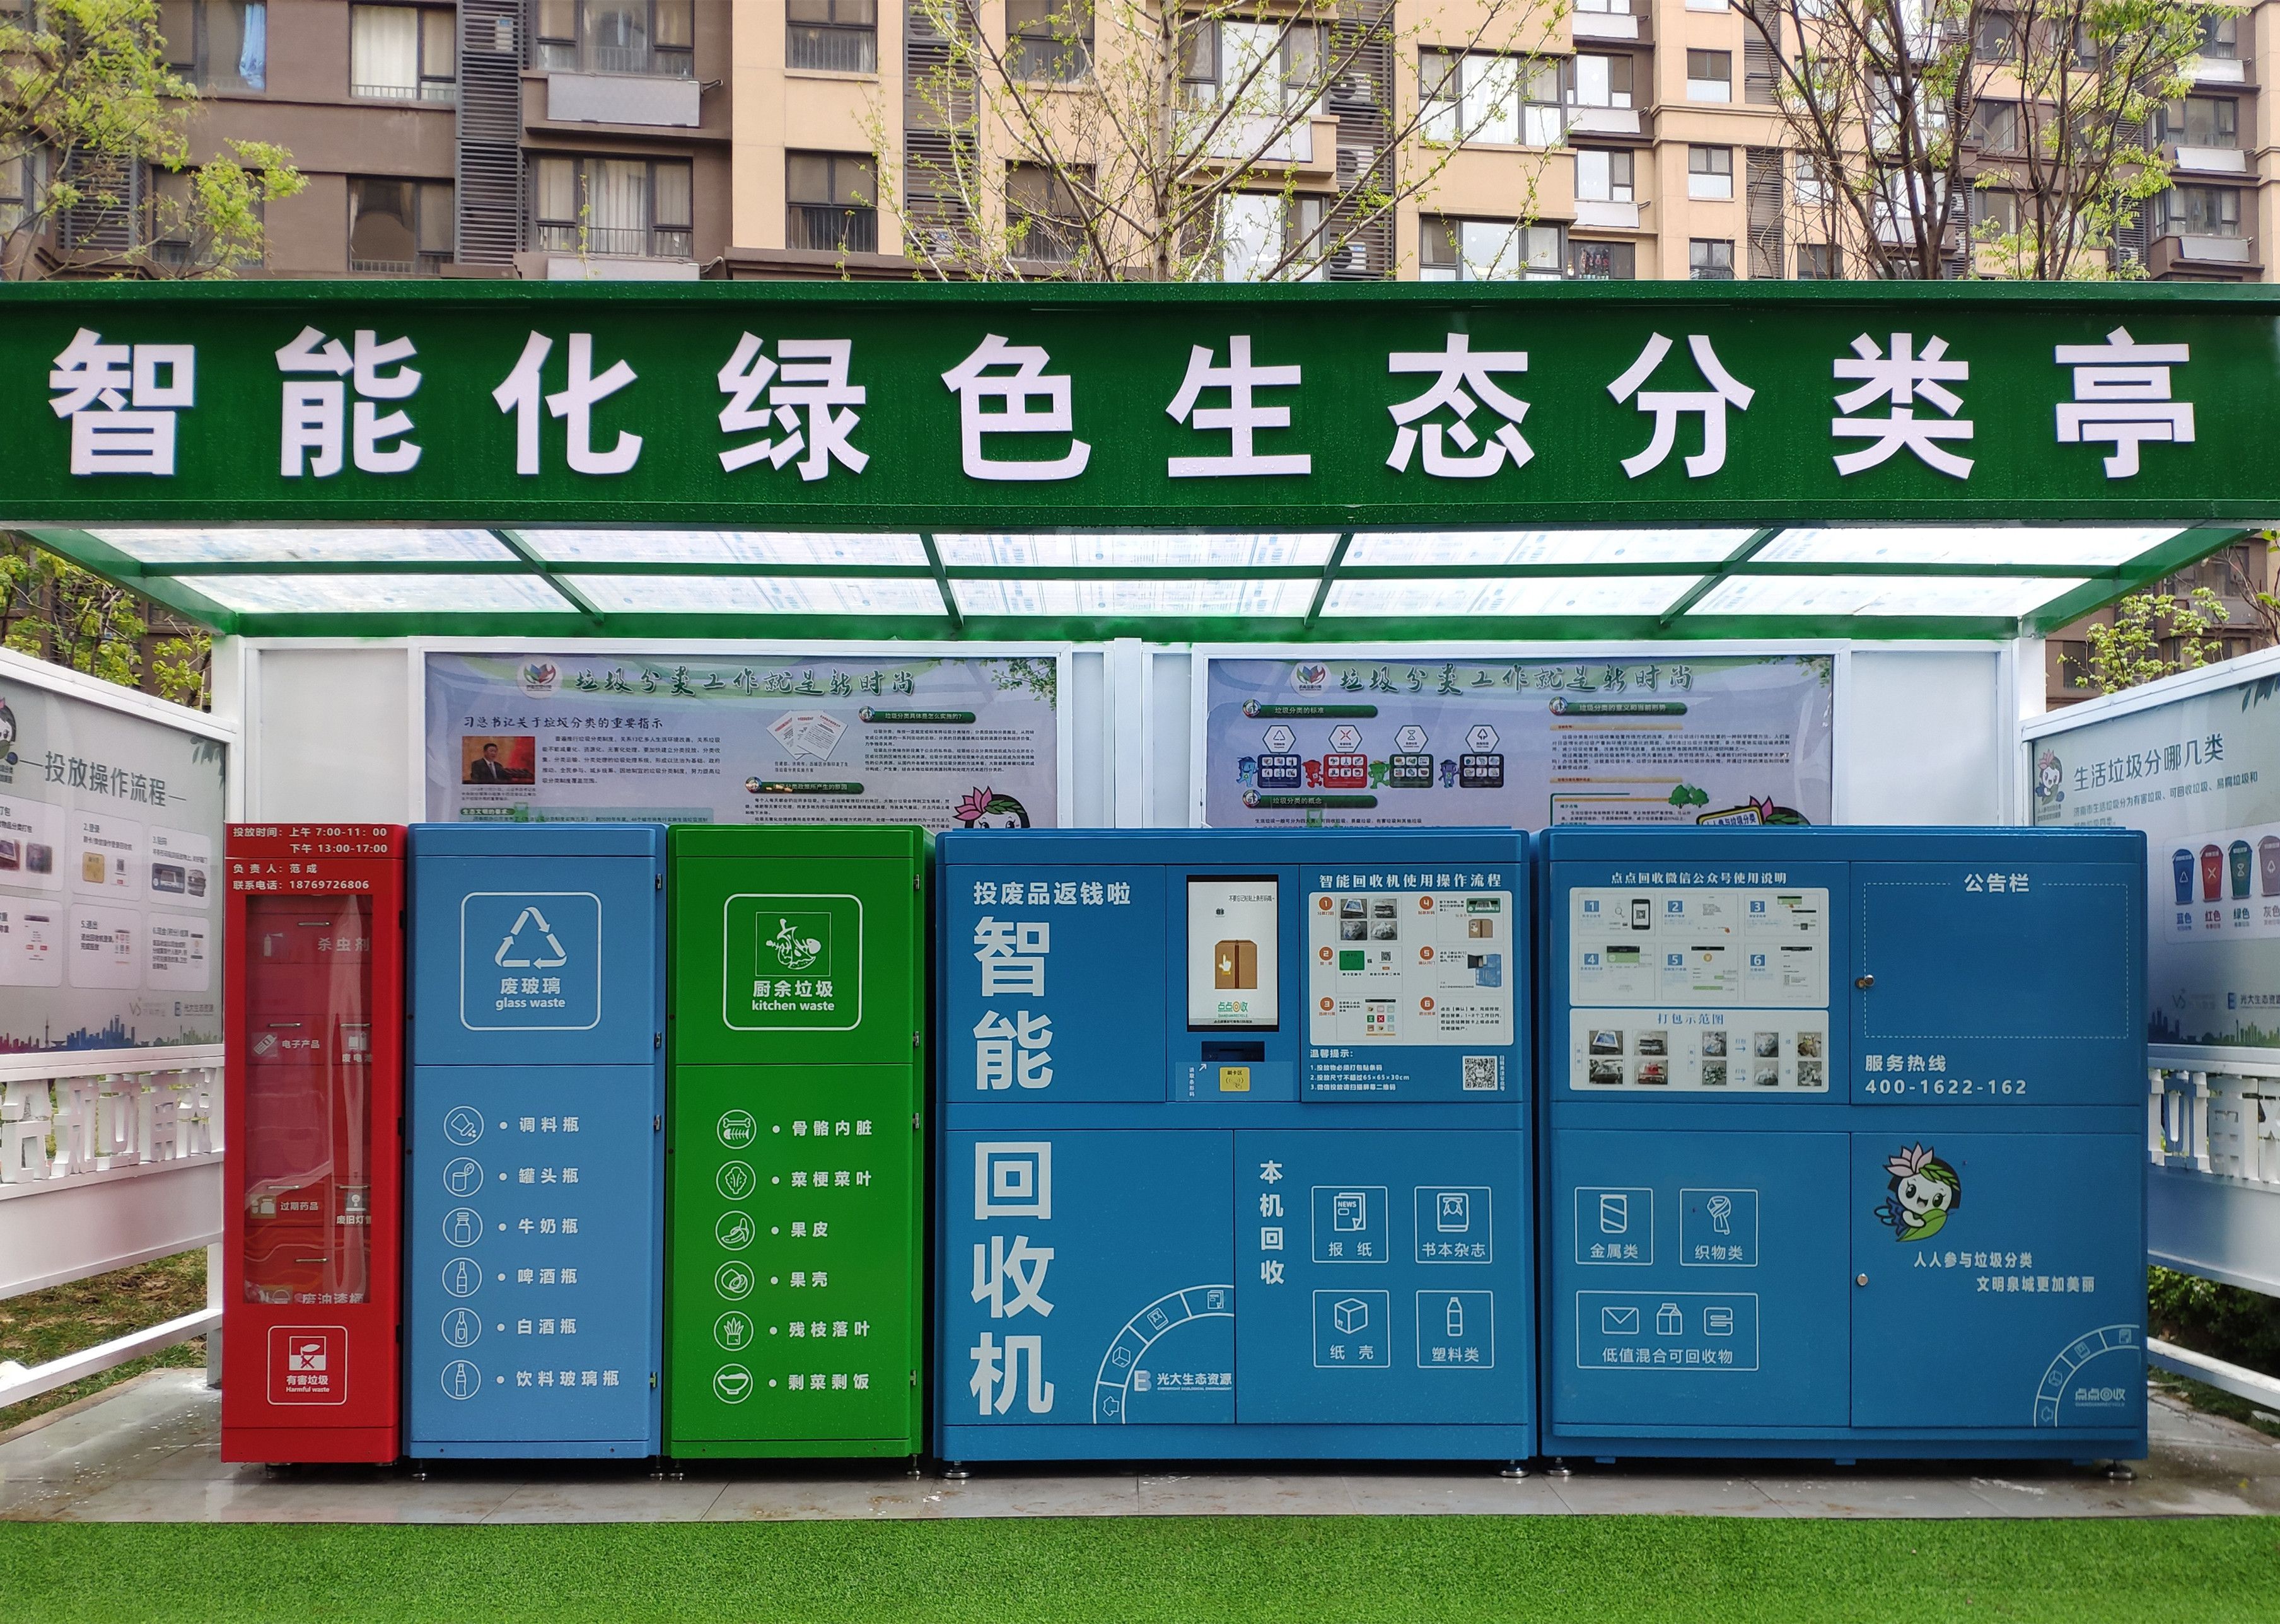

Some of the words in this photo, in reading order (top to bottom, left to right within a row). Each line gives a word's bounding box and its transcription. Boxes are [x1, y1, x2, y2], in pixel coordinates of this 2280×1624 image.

[49, 326, 2196, 481] 智能化绿色生态分类亭
[575, 665, 914, 697] 垃圾分类工作就是新时尚
[1339, 663, 1694, 695] 垃圾分类工作就是新时尚
[464, 716, 663, 729] 习总书记关于垃圾分类的重要指示
[2073, 733, 2224, 792] 生活垃圾分哪几类
[45, 751, 166, 807] 投放操作流程
[1272, 797, 1322, 805] 垃圾分类的概念
[289, 844, 311, 854] 下午
[318, 844, 388, 853] 13:00-17:00
[233, 880, 369, 890] 联系电话：18769726806
[1319, 874, 1502, 888] 智能回收机使用操作流程
[1611, 872, 1787, 884] 点点回收微信公众号使用说明
[1963, 873, 2030, 893] 公告栏
[974, 881, 1131, 905] 投废品返钱啦
[2205, 910, 2221, 922] 红色
[2233, 908, 2250, 920] 绿色
[2263, 905, 2280, 917] 灰色
[318, 937, 370, 952] 杀虫剂
[500, 977, 561, 995] 废玻璃
[753, 980, 833, 998] 厨余垃圾
[495, 997, 527, 1011] glass
[529, 999, 566, 1009] waste
[752, 1000, 797, 1011] kitchen
[800, 1002, 835, 1011] waste
[1657, 1013, 1725, 1025] 打包示范图
[282, 1040, 320, 1049] 电子产品
[1865, 1054, 1946, 1072] 服务热线
[1865, 1079, 2027, 1094] 400-1622-162
[519, 1116, 579, 1134] 调料瓶
[792, 1120, 873, 1137] 骨骼内脏
[970, 916, 1054, 1415] 智能回收机
[518, 1168, 579, 1185] 罐头瓶
[791, 1171, 871, 1188] 菜梗菜叶
[281, 1202, 318, 1211] 过期药品
[518, 1218, 579, 1235] 牛奶瓶
[791, 1222, 829, 1238] 果皮
[1259, 1160, 1284, 1284] 本机回收
[1329, 1242, 1372, 1257] 报纸
[1422, 1242, 1486, 1257] 书本杂志
[1590, 1243, 1638, 1259] 金属类
[1695, 1244, 1743, 1260] 织物类
[1914, 1251, 2033, 1268] 人人参与垃圾分类
[517, 1268, 578, 1285] 啤酒瓶
[790, 1272, 828, 1288] 果壳
[1977, 1276, 2095, 1292] 文明泉城更加美丽
[516, 1319, 576, 1335] 白酒瓶
[789, 1321, 870, 1338] 残枝落叶
[1330, 1345, 1373, 1360] 纸壳
[1432, 1347, 1479, 1362] 塑料类
[1602, 1347, 1733, 1364] 低值混合可回收物
[286, 1375, 329, 1385] 有害垃圾
[516, 1371, 619, 1388] 饮料玻璃瓶
[788, 1374, 870, 1391] 剩菜剩饭
[1157, 1372, 1232, 1385] 光大生态资源
